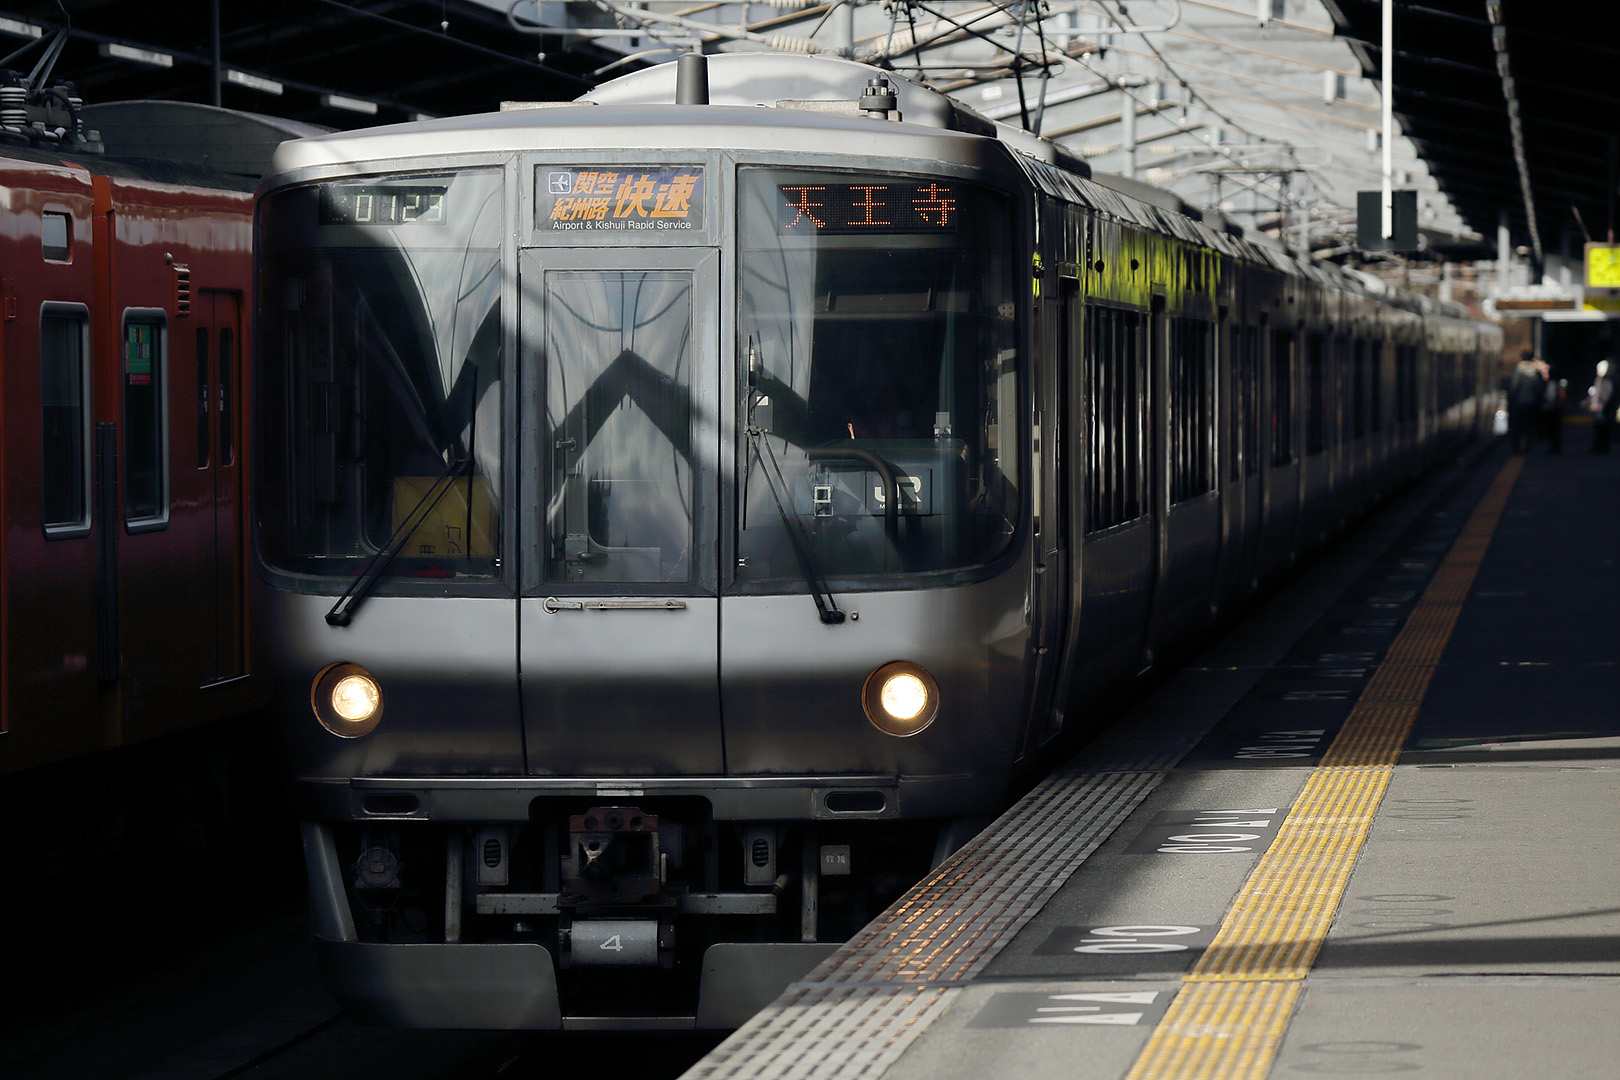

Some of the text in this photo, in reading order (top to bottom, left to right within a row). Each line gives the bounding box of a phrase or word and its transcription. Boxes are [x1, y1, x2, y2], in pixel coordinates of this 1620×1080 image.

[571, 171, 619, 195] 関空
[612, 174, 699, 218] 快速
[782, 183, 956, 228] 天王寺
[549, 197, 612, 221] 紀州路
[552, 220, 692, 231] Airport & Kishuji Rapid Service
[599, 934, 624, 952] 4
